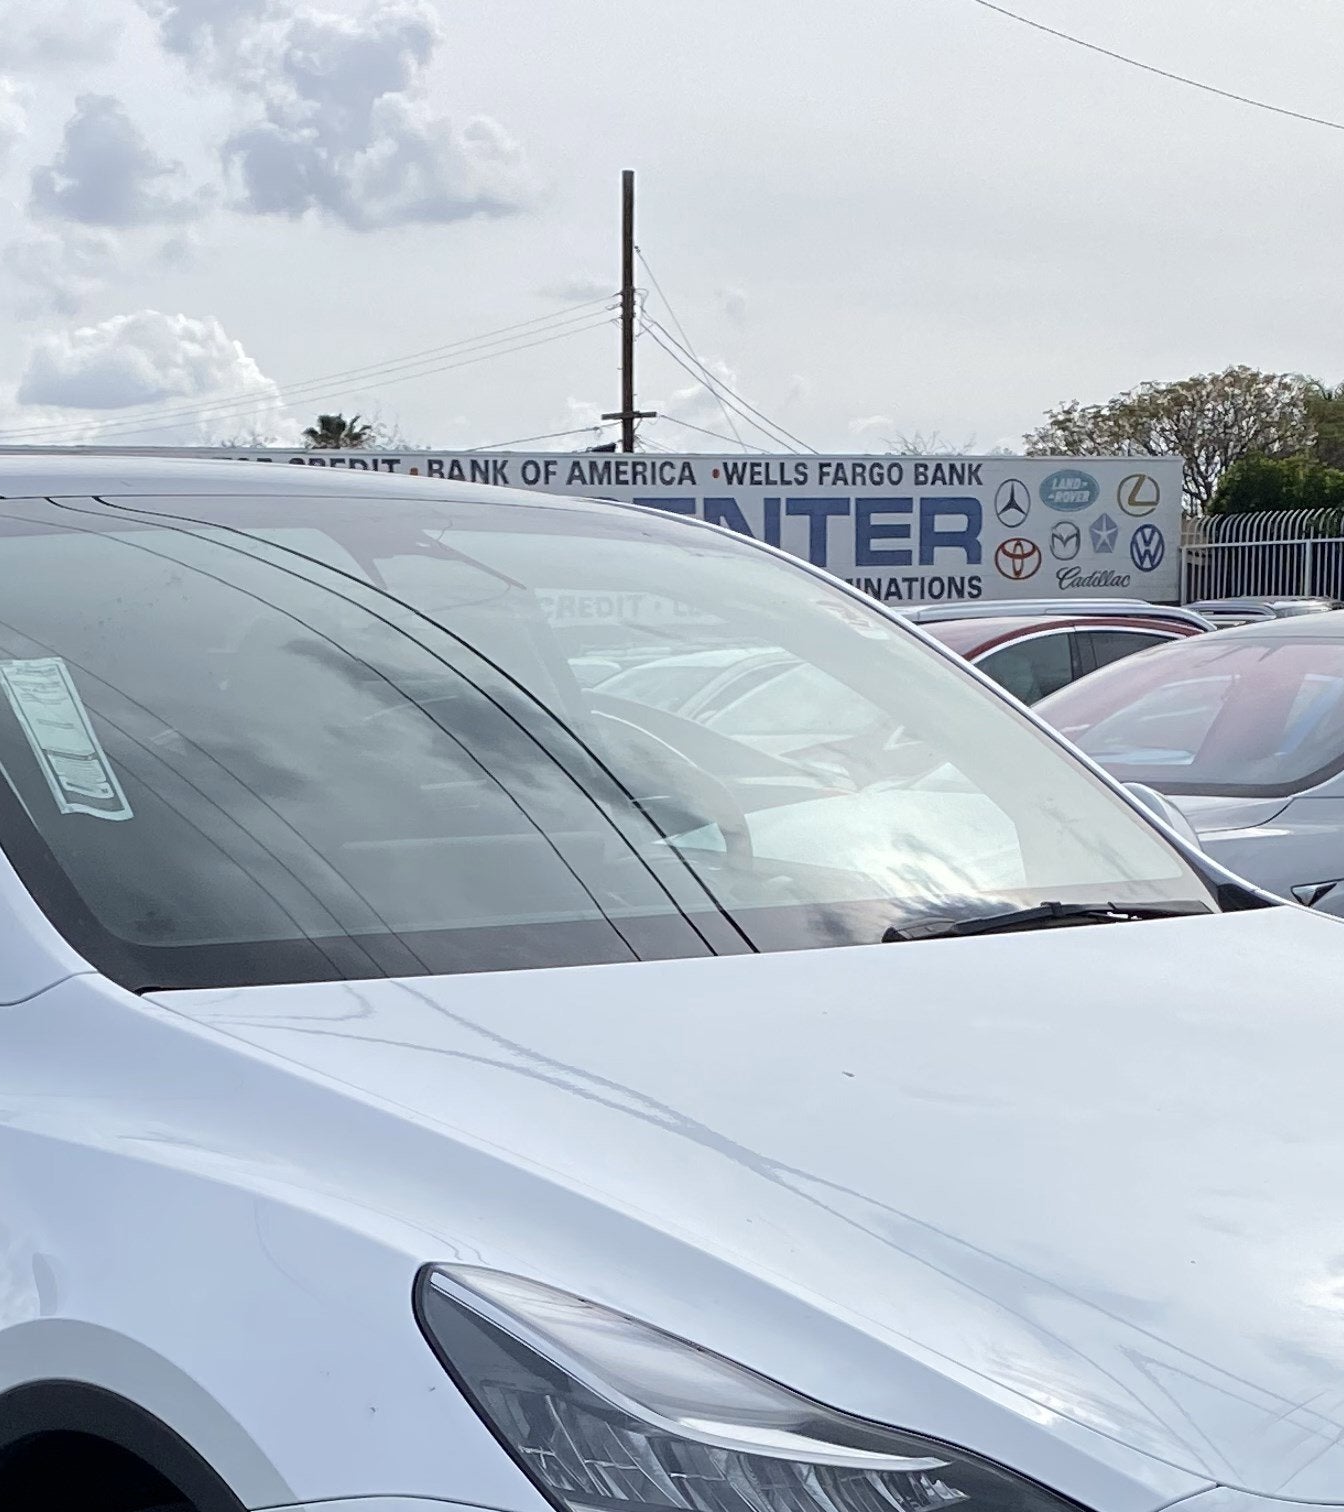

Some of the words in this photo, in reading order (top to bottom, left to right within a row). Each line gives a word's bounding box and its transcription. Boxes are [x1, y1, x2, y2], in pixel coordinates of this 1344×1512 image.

[427, 459, 509, 486] BANK
[520, 459, 558, 486] OF
[565, 460, 697, 486] AMERICA
[722, 461, 808, 486] WELLS
[818, 462, 904, 486] FARGO
[913, 462, 984, 486] BANK
[621, 496, 983, 568] NTER
[845, 575, 983, 601] NATIONS
[1056, 565, 1131, 590] Cadillac
